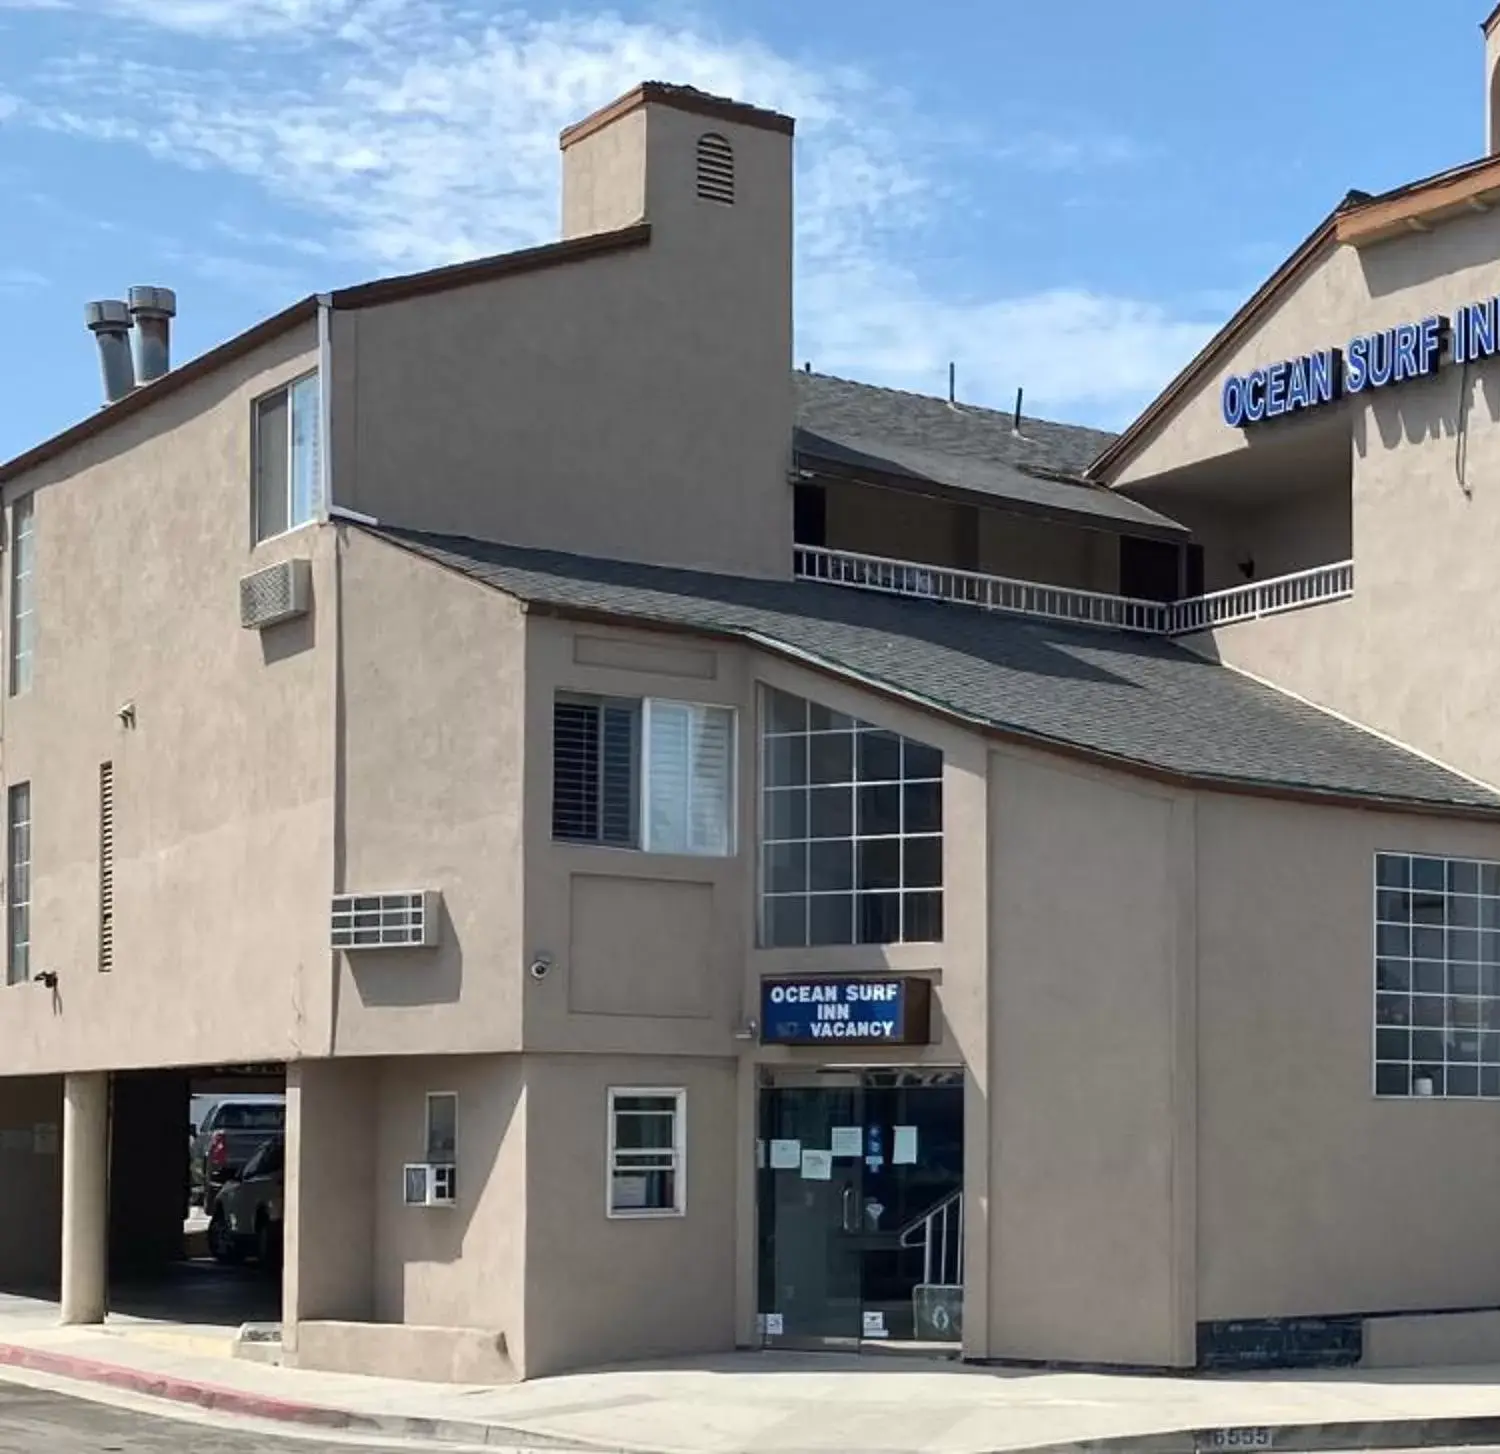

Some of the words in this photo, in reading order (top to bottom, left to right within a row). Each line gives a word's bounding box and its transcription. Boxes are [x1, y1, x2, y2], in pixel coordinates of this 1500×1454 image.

[1221, 348, 1342, 428] OCEAN
[1344, 315, 1449, 393] SURF
[770, 985, 838, 1003] OCEAN
[845, 983, 899, 1002] SURF
[817, 1004, 850, 1020] INN
[810, 1021, 894, 1038] VACANCY
